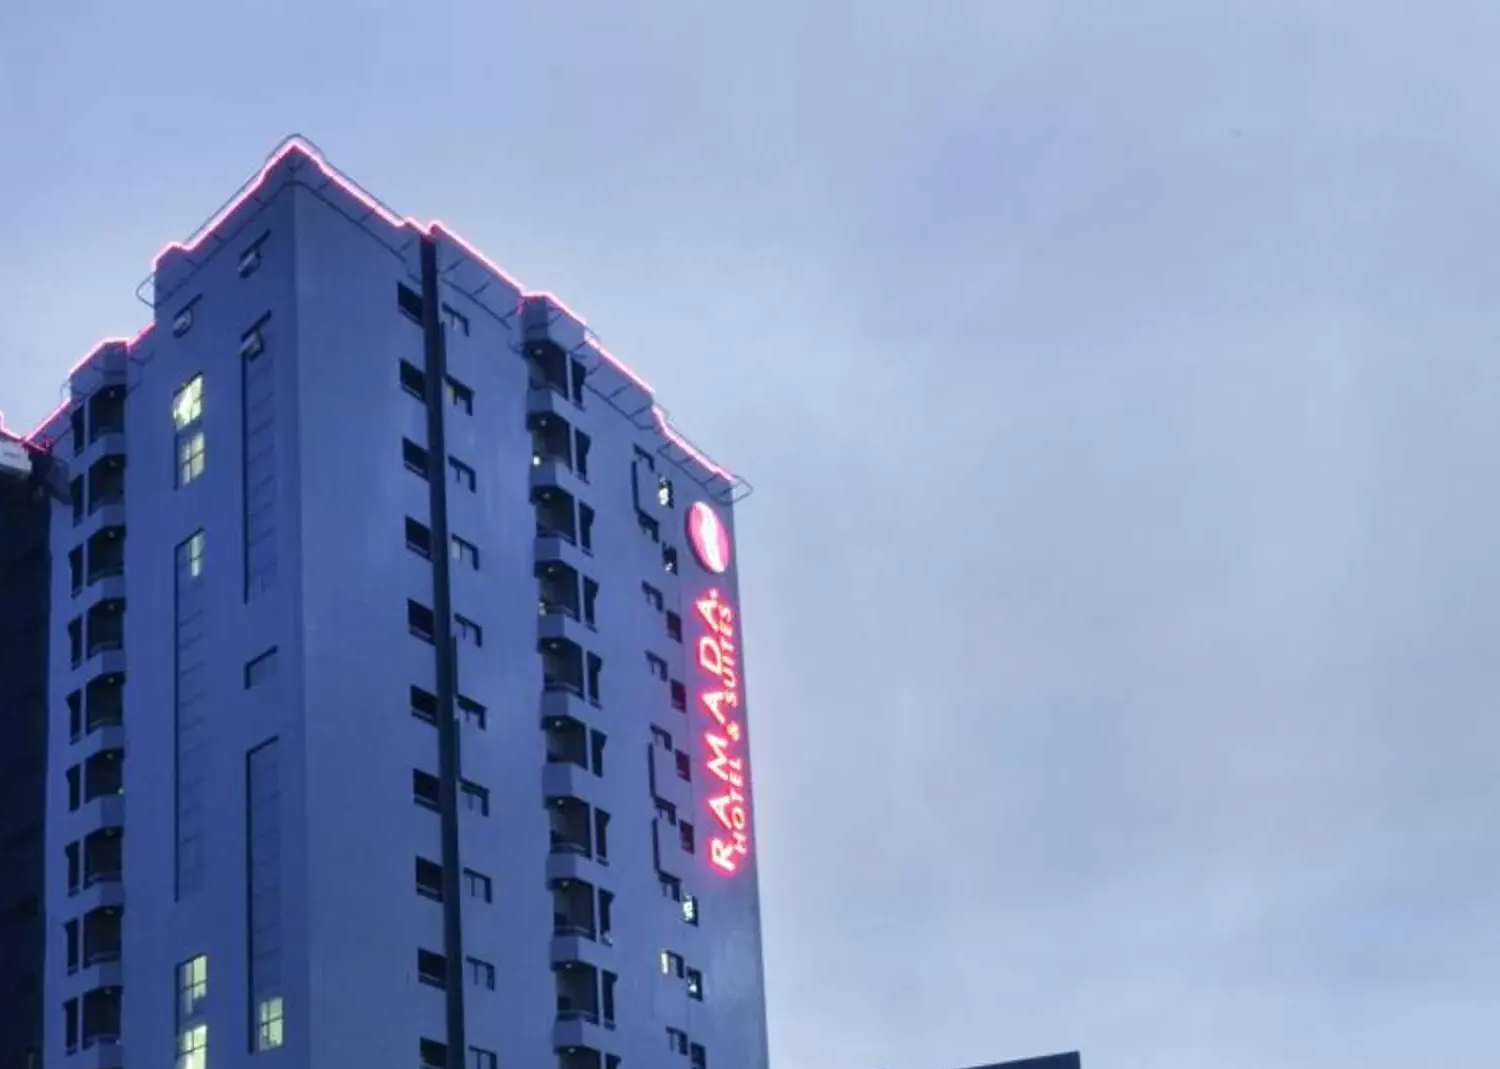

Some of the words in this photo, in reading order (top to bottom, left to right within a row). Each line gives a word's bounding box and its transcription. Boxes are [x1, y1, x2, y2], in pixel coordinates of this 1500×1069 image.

[719, 605, 738, 708] SUITES
[696, 597, 735, 871] RAMADA
[726, 722, 740, 741] &
[728, 757, 748, 855] HOTEL
